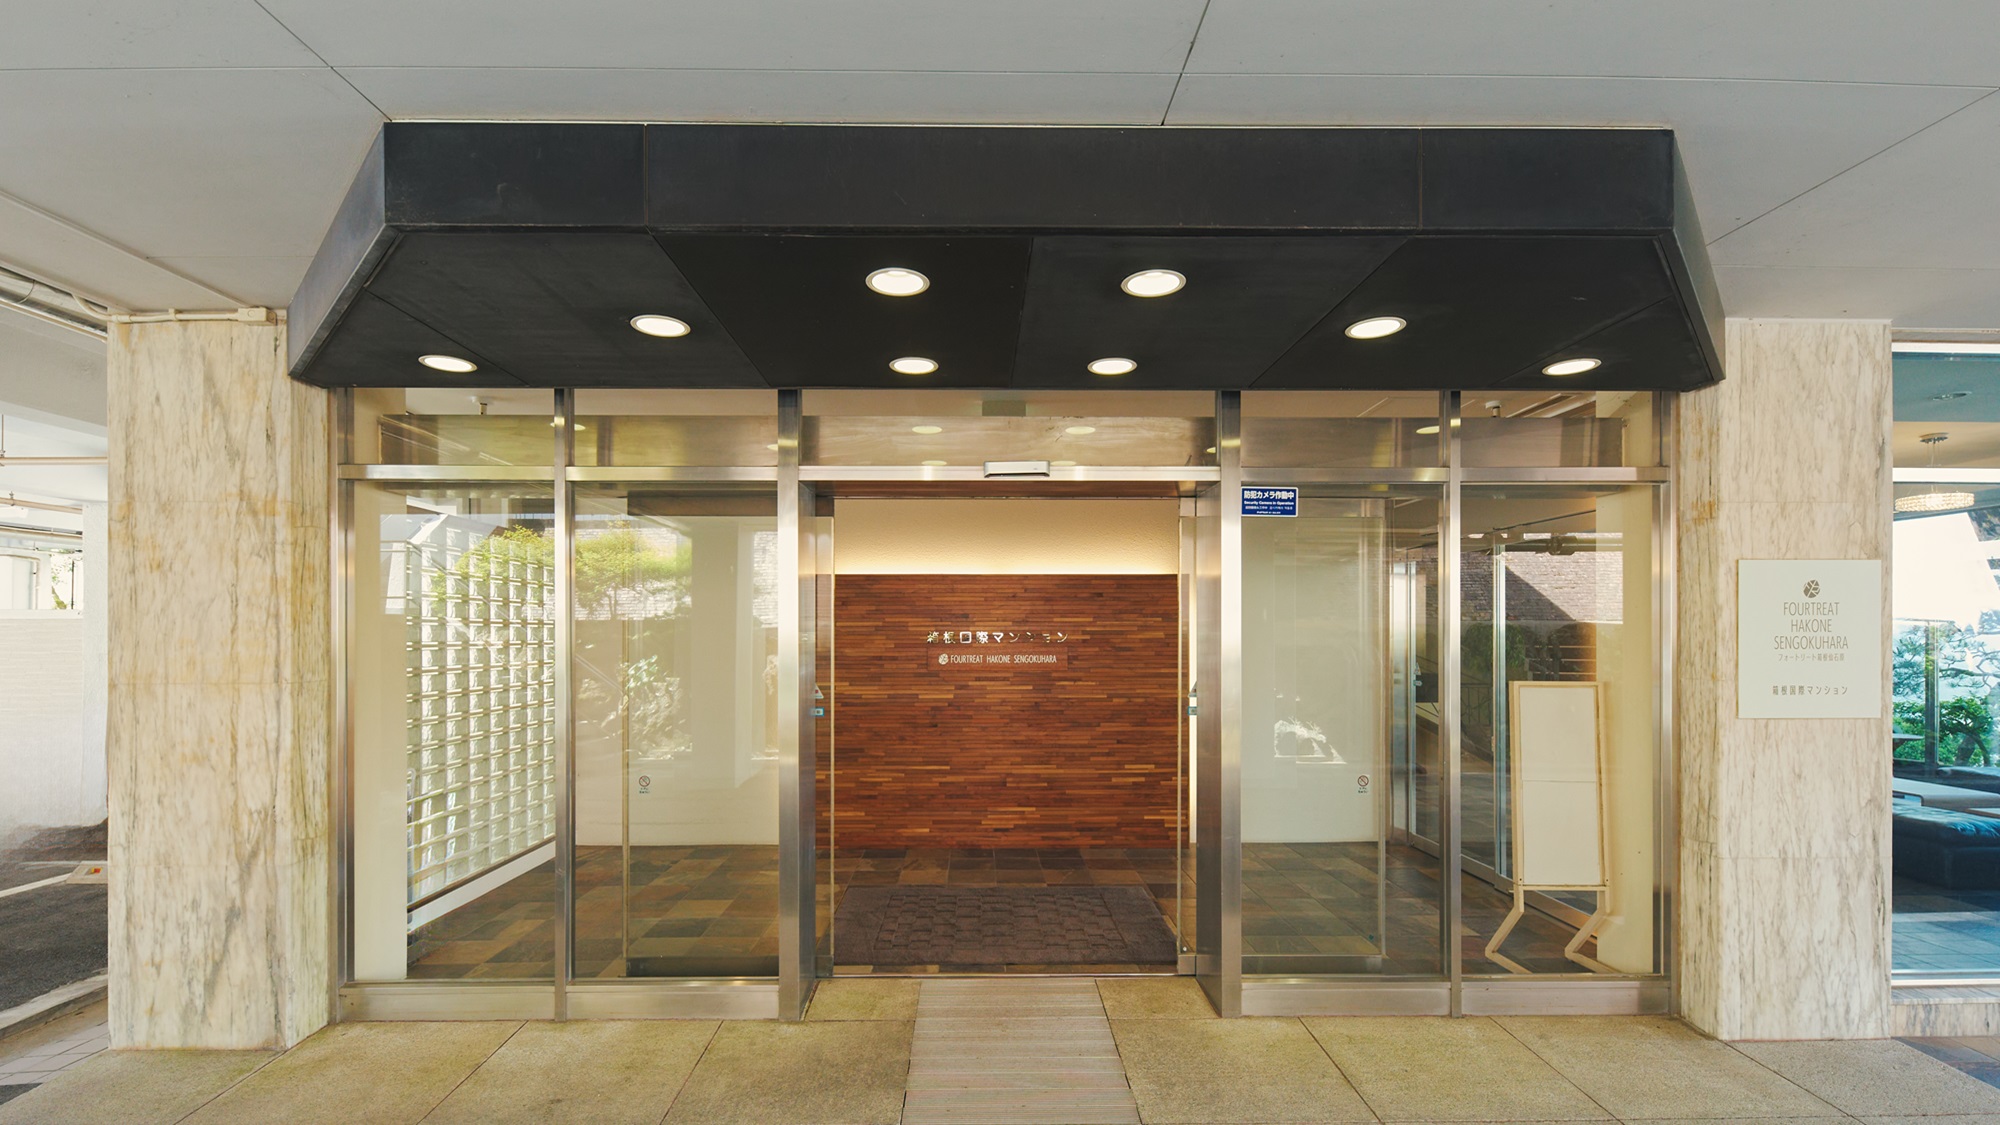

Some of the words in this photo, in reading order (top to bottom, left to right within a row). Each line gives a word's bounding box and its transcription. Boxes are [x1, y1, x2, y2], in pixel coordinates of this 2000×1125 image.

[1243, 490, 1294, 499] 防犯カメラ作動中
[1783, 601, 1840, 616] FOURTREAT
[1790, 618, 1832, 633] HAKONE
[1774, 635, 1849, 650] SENGOKUHARA
[950, 654, 983, 664] FOURTREAT
[986, 654, 1011, 664] HAKONE
[1013, 654, 1057, 664] SENGOKUHARA
[1778, 653, 1845, 662] フォートリート箱根仙石原
[1772, 685, 1848, 696] 箱根国際マンション
